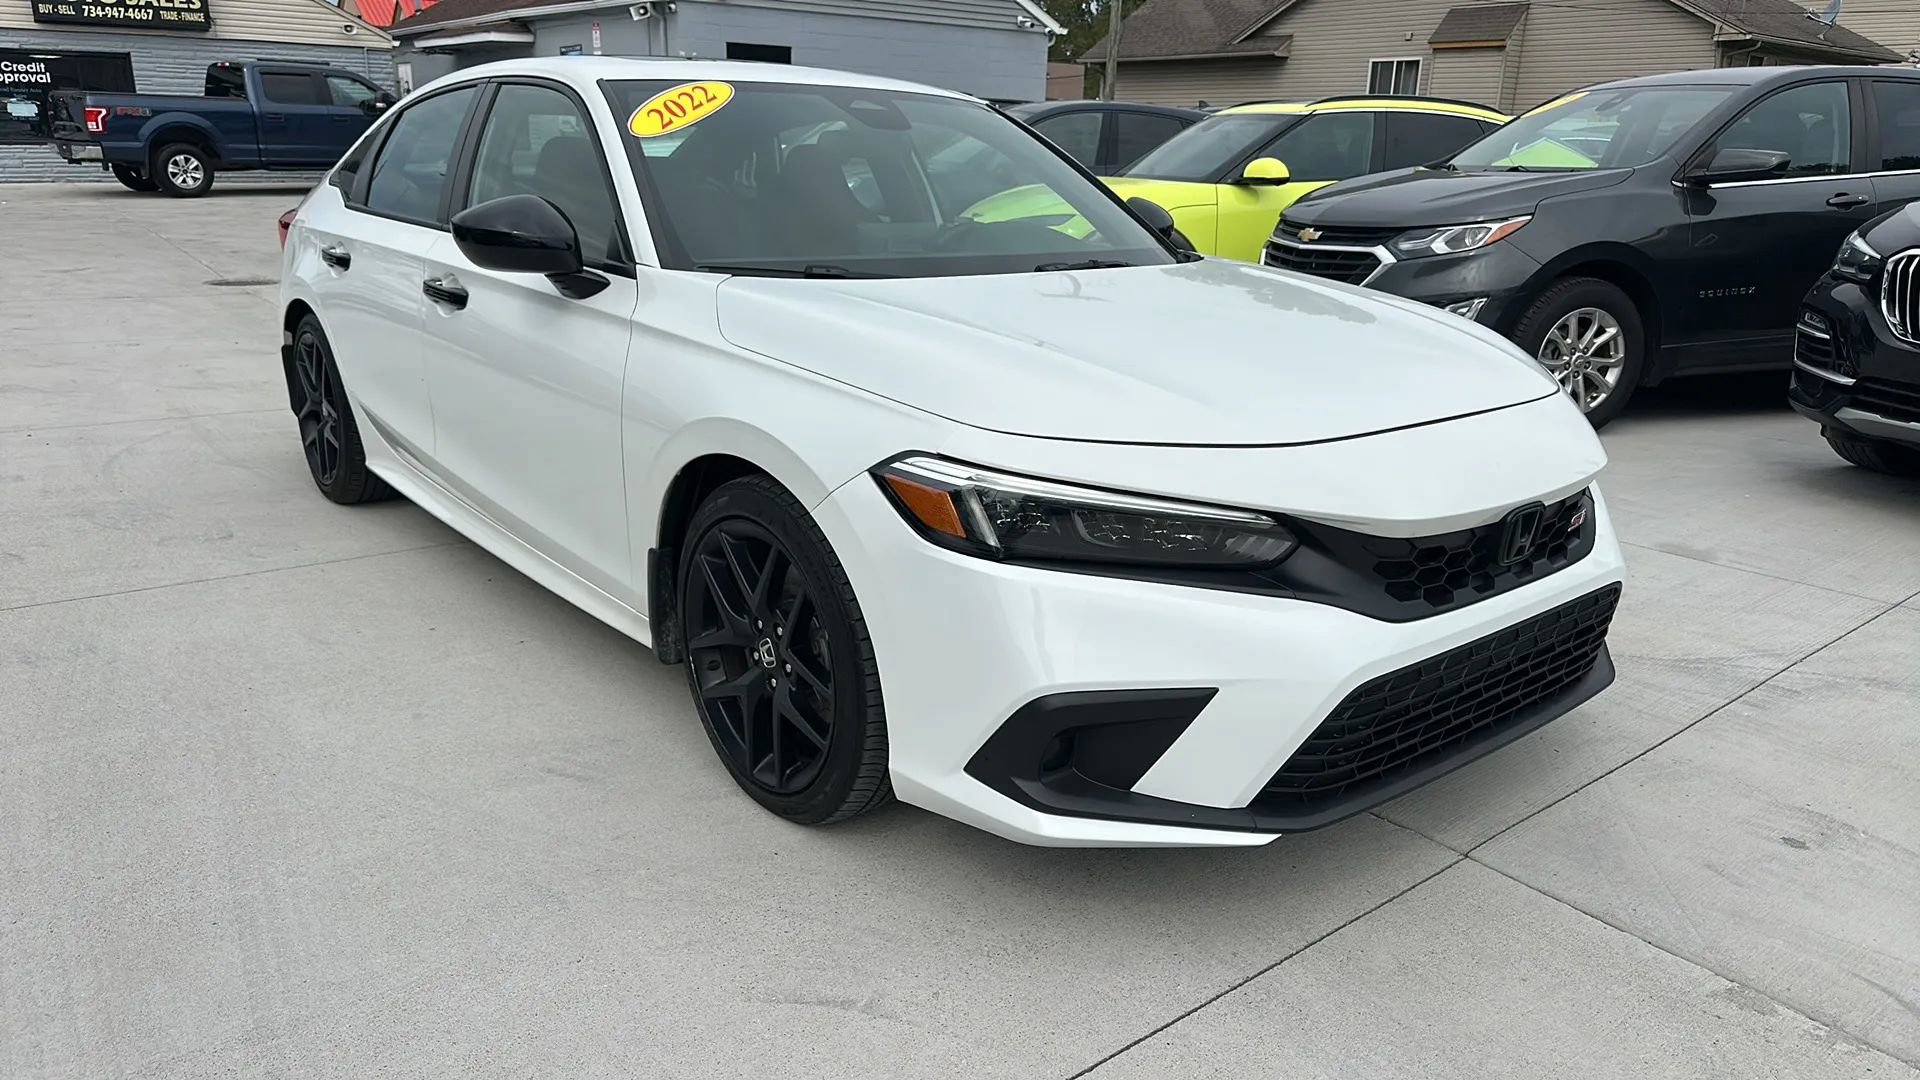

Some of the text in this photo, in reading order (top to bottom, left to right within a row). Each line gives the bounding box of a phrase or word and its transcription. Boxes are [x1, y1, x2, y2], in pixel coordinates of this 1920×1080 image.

[38, 3, 53, 14] BUY
[58, 4, 76, 15] SELL
[82, 5, 153, 20] 734-947-4667
[1, 61, 45, 73] Credit
[647, 85, 718, 130] 2022
